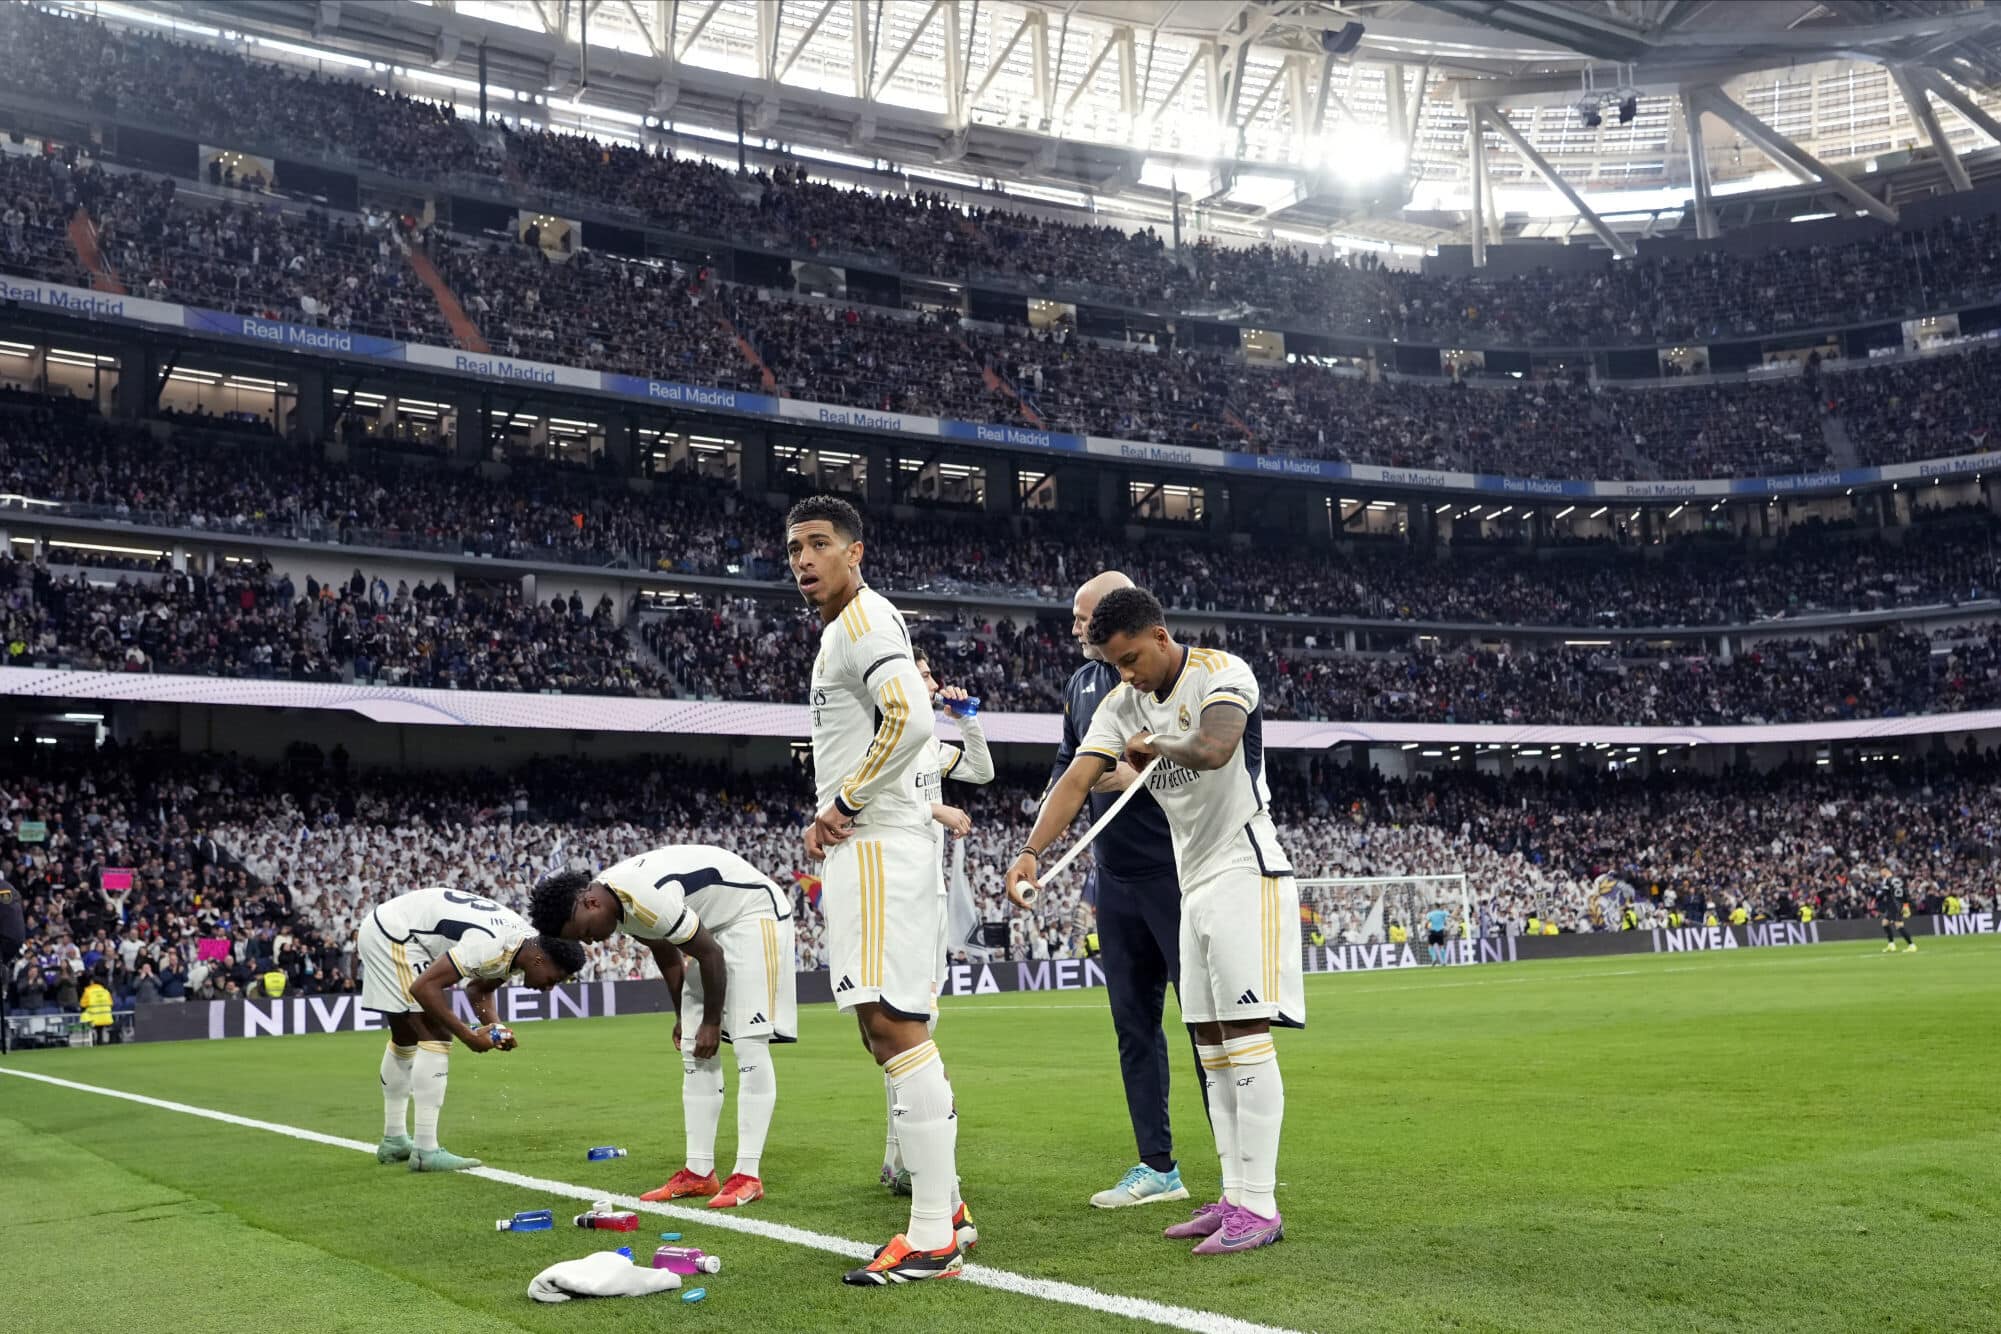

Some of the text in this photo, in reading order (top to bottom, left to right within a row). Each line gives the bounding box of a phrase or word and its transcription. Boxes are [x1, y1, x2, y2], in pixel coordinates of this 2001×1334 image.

[49, 289, 125, 316] Madrid
[243, 320, 351, 351] Real Madrid
[455, 356, 555, 384] Real Madrid
[649, 382, 735, 407] Real Madrid
[819, 408, 901, 430] Real Madrid
[977, 426, 1050, 447] Real Madrid
[1121, 445, 1192, 463] Real Madrid
[1257, 457, 1320, 474] Real Madrid
[1920, 464, 1951, 477] Real
[1382, 471, 1445, 487] Real Madrid
[1503, 480, 1562, 494] Real Madrid
[1767, 473, 1841, 490] Real Madrid
[1626, 485, 1695, 497] Real Madrid
[1943, 913, 2001, 935] NIVE
[1666, 921, 1807, 952] NIVEA MEN
[1325, 942, 1418, 972] NIVEA
[244, 996, 383, 1038] NIVE
